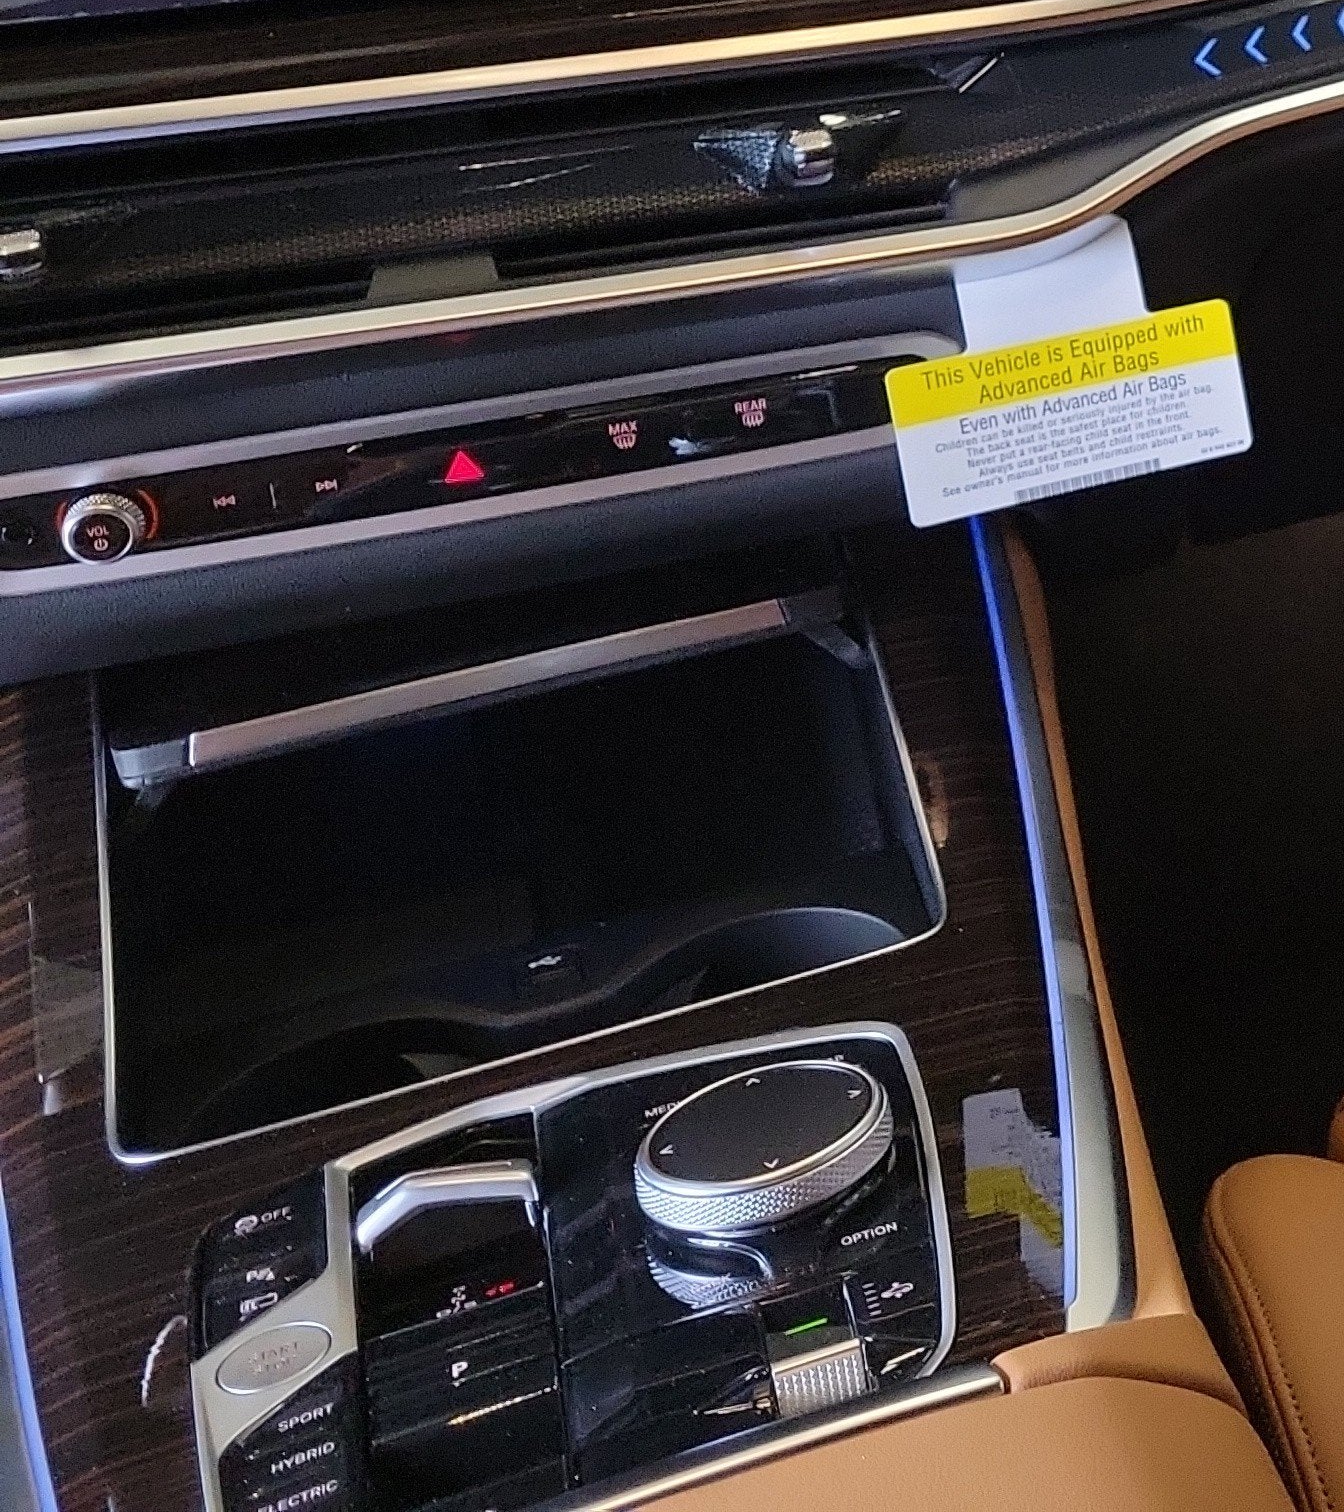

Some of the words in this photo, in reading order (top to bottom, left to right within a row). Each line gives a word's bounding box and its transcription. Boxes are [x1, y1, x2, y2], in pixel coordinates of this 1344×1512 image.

[922, 368, 963, 390] This
[970, 351, 1040, 379] Vehicle
[1070, 324, 1158, 358] Equipped
[1164, 315, 1203, 337] with
[979, 367, 1072, 403] Advanced
[1081, 360, 1106, 380] Air
[1114, 351, 1159, 372] Bags
[960, 414, 997, 434] Even
[1003, 405, 1036, 424] with
[1042, 387, 1117, 416] Advanced
[1123, 381, 1143, 398] Air
[1149, 373, 1186, 392] Bags
[608, 420, 638, 436] MAX
[86, 525, 109, 538] VOL
[841, 1221, 898, 1247] OPTION
[451, 1361, 468, 1378] P
[277, 1402, 335, 1433] SPORT
[270, 1441, 335, 1475] HYBRID
